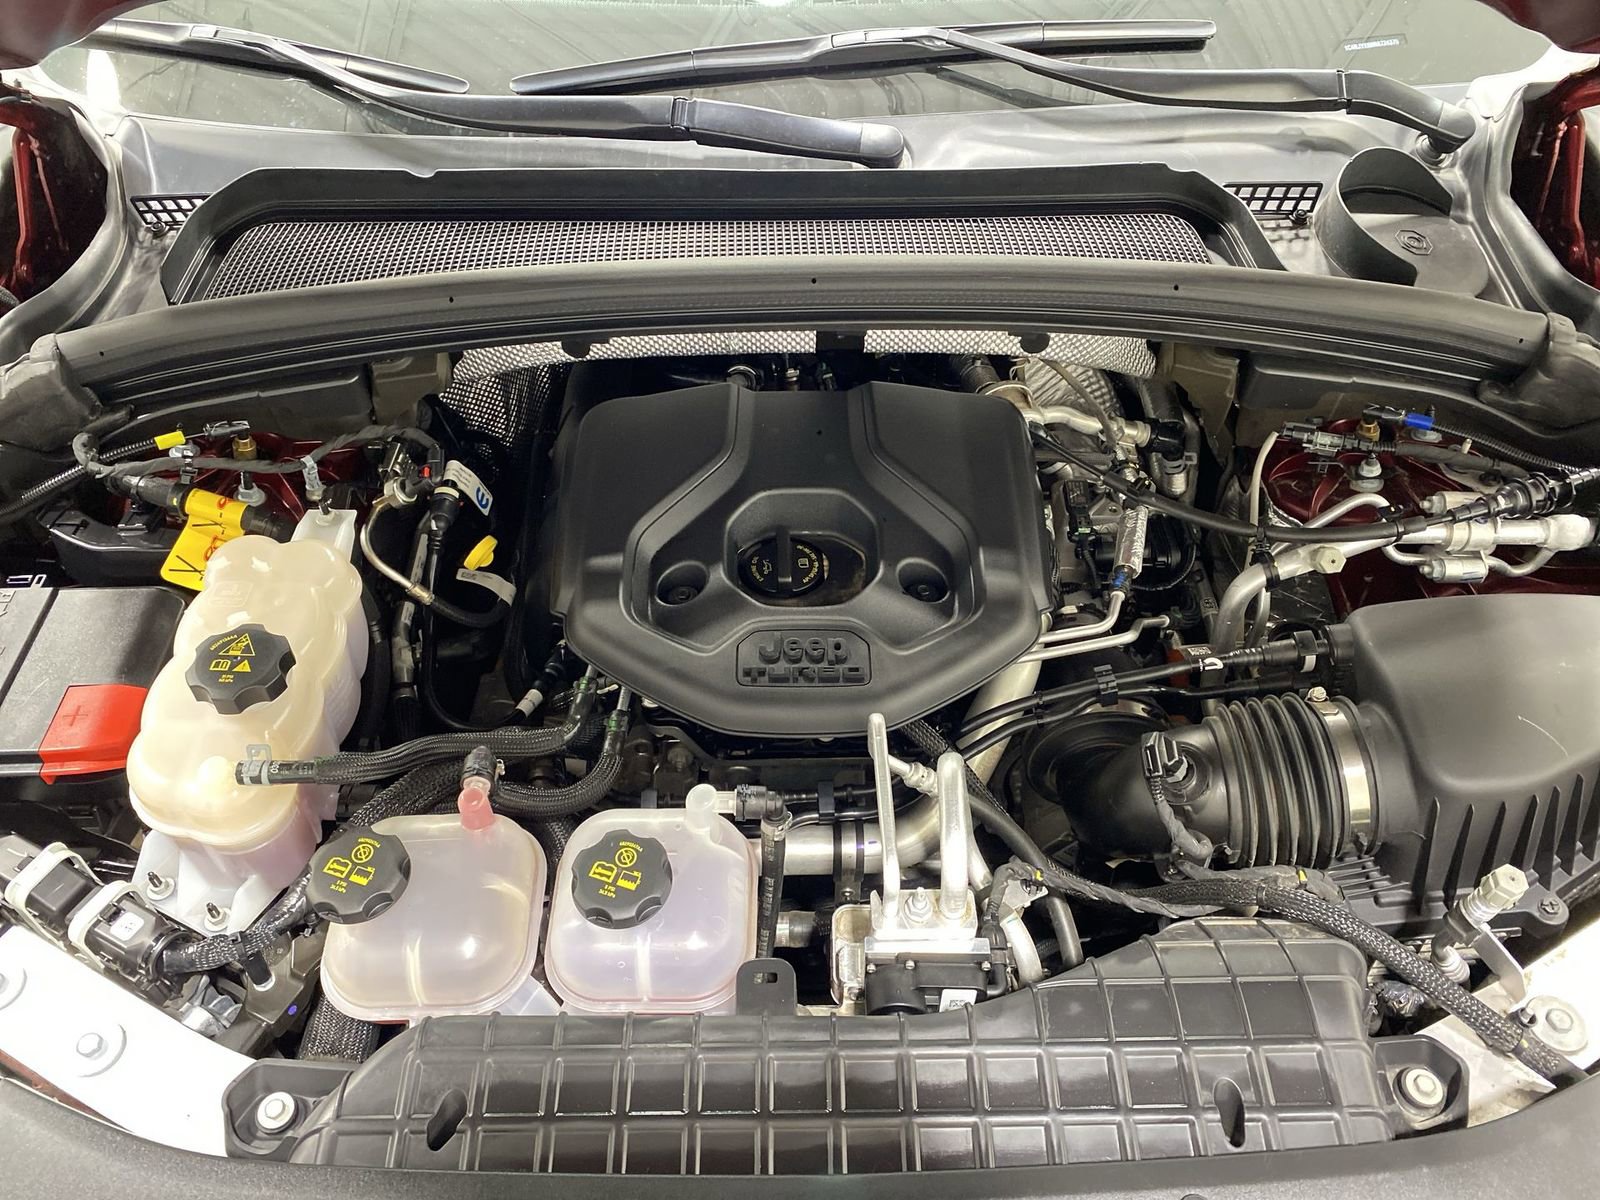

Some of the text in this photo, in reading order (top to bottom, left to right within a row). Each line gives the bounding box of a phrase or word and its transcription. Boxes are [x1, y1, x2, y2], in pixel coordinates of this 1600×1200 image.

[750, 565, 764, 582] ENGINE
[759, 632, 849, 665] Jeep
[742, 666, 865, 683] TURBO
